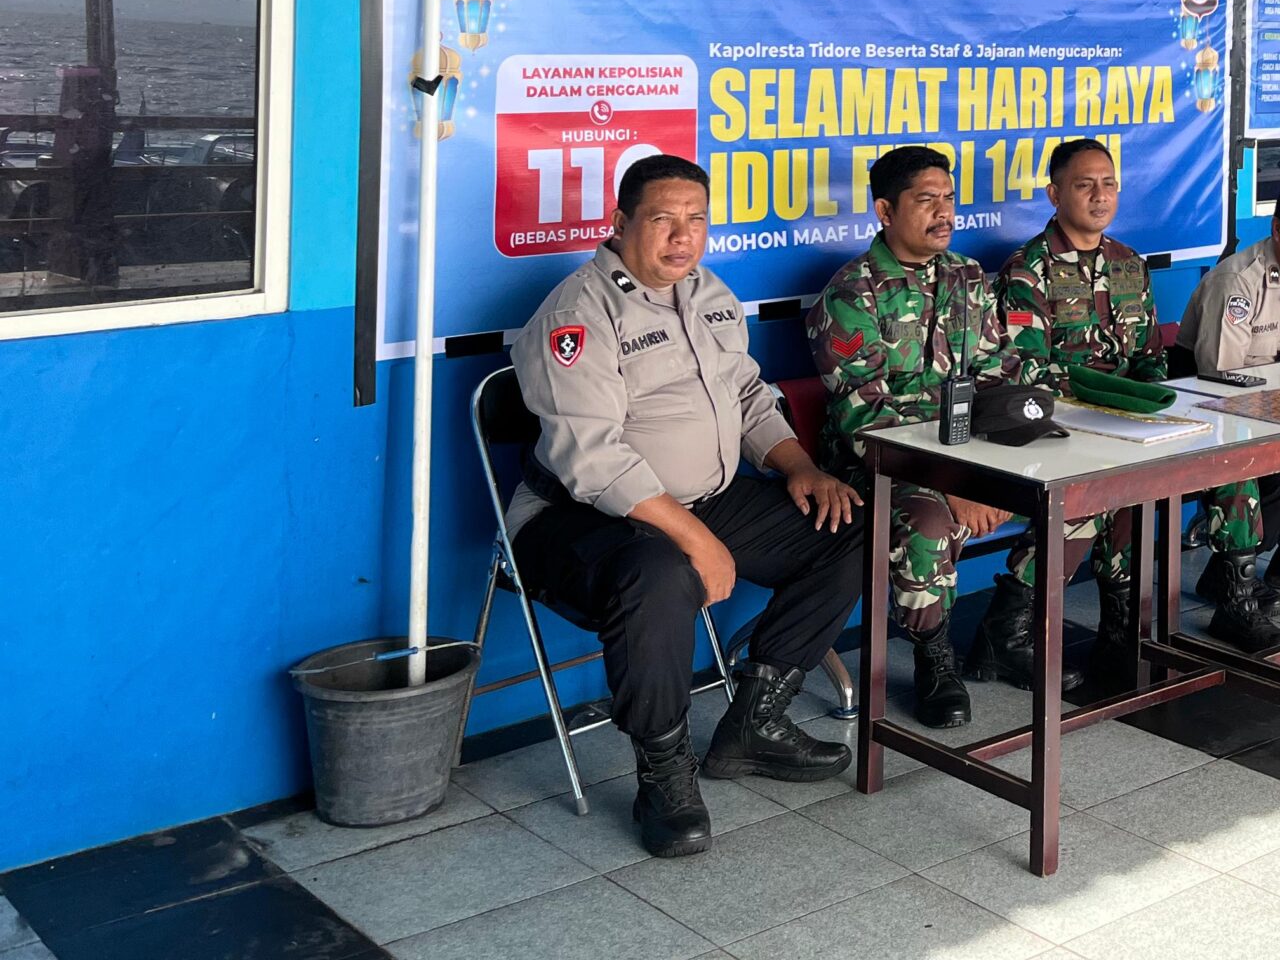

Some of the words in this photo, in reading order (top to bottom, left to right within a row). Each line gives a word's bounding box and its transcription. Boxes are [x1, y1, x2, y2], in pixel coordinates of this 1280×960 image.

[709, 42, 805, 61] Kapolresta
[808, 42, 861, 59] Tidore
[865, 43, 926, 59] Beserta
[930, 43, 960, 58] Staf
[962, 43, 973, 58] &
[976, 44, 1025, 61] Jajaran
[1028, 44, 1122, 60] Mengucapkan:
[522, 66, 597, 80] LAYANAN
[599, 65, 683, 79] KEPOLISIAN
[526, 84, 583, 98] DALAM
[586, 82, 680, 97] GENGGAMAN
[709, 67, 953, 142] SELAMAT
[958, 67, 1064, 131] HARI
[1074, 65, 1175, 124] RAYA
[562, 129, 630, 142] HUBUNGI
[709, 147, 839, 225] IDUL
[510, 227, 567, 246] (BEBAS
[709, 230, 788, 254] MOHON
[794, 226, 850, 245] MAAF
[954, 211, 1001, 232] BATIN
[620, 328, 670, 356] DAHREIN
